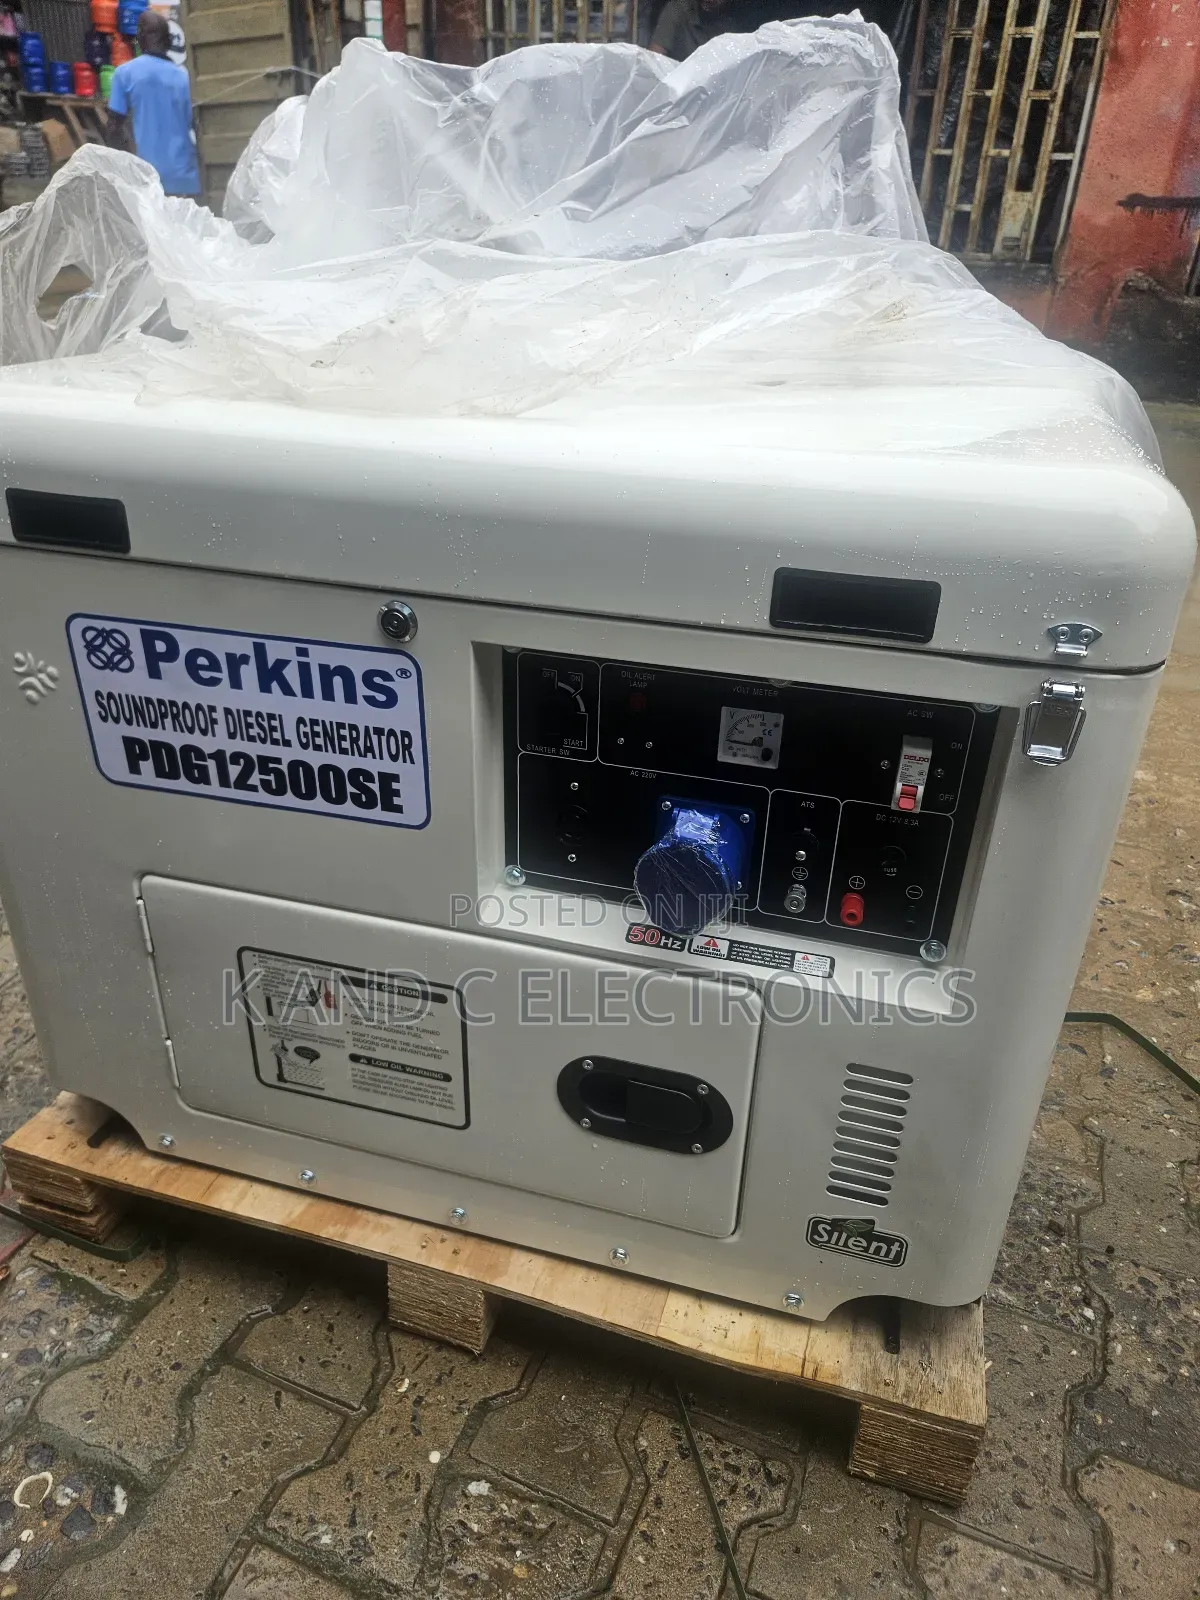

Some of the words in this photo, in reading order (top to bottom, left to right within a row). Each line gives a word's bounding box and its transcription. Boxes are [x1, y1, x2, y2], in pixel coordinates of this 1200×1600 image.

[542, 671, 555, 679] OFF
[570, 674, 581, 682] ON
[621, 670, 632, 679] OIL
[633, 673, 656, 682] ALERT
[629, 680, 648, 689] LAMP
[732, 686, 749, 695] VOLT
[752, 689, 779, 697] METER
[906, 709, 918, 717] AC
[920, 711, 934, 719] SW
[94, 689, 219, 738] SOUNDPROOF
[224, 707, 292, 748] DIESEL
[296, 716, 415, 765] GENERATOR
[563, 737, 584, 748] START
[951, 742, 963, 750] ON
[526, 743, 557, 754] STARTER
[559, 748, 571, 756] SW
[122, 735, 404, 814] PDG12500SE
[629, 769, 639, 778] AC
[641, 771, 657, 779] 220V
[939, 793, 954, 802] OFF
[800, 800, 815, 809] ATS
[875, 813, 886, 821] DC
[889, 816, 902, 824] 12V
[381, 985, 419, 997] CAUTION
[371, 1059, 389, 1068] LOW
[390, 1063, 403, 1071] OIL
[405, 1066, 444, 1080] WARNING
[813, 1223, 902, 1259] Silent
